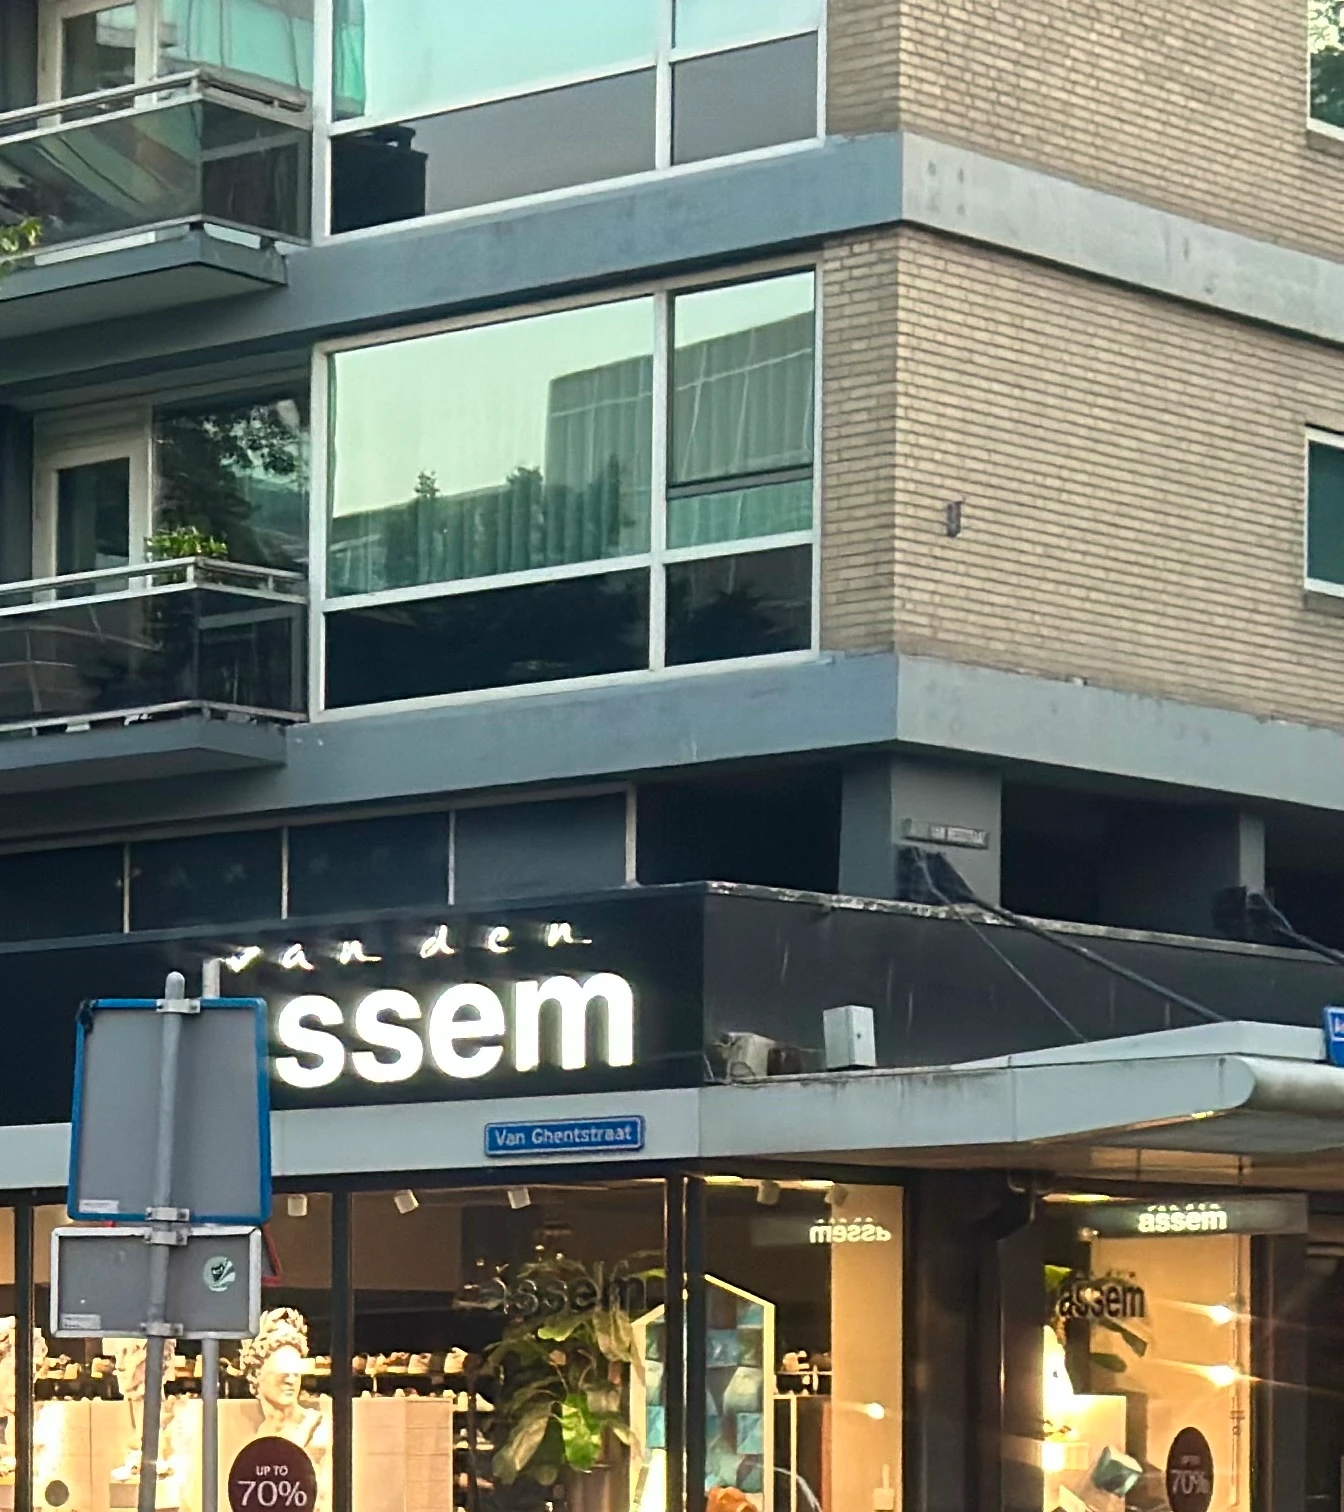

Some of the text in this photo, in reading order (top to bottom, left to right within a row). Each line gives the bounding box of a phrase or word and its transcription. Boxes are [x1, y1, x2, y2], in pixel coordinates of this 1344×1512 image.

[224, 920, 593, 973] van den
[275, 972, 634, 1088] ssem
[495, 1125, 633, 1147] Van Ghentstraat
[1138, 1210, 1228, 1233] assem
[255, 1465, 289, 1476] UP TO
[1170, 1469, 1210, 1495] 70%
[237, 1480, 308, 1507] 70%
